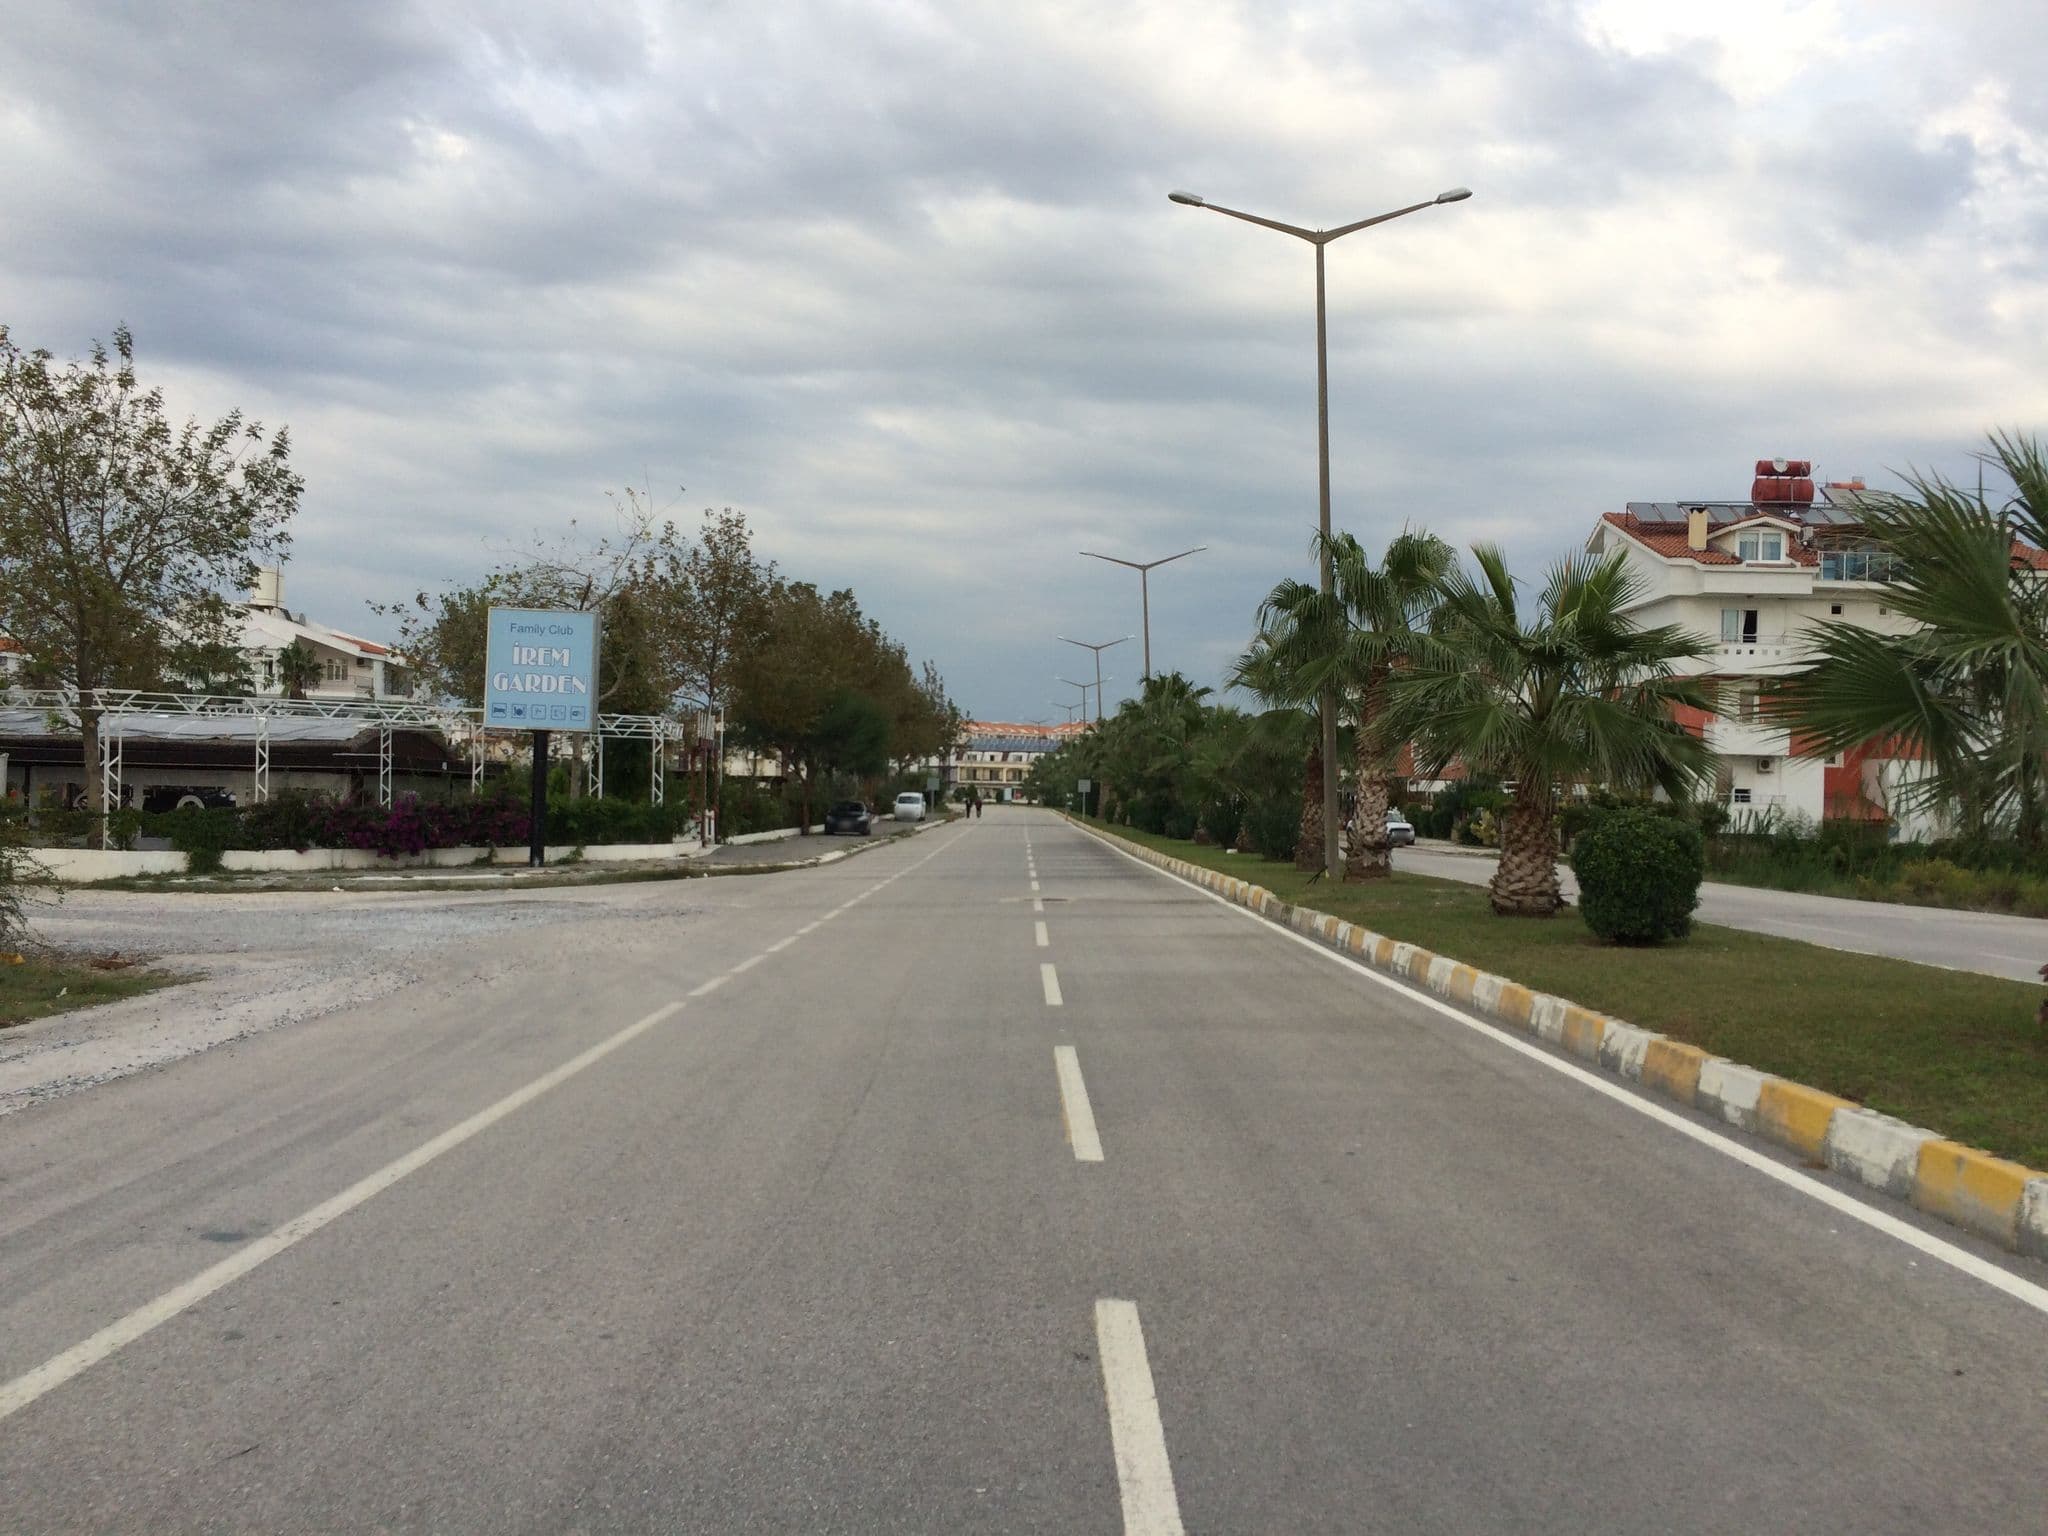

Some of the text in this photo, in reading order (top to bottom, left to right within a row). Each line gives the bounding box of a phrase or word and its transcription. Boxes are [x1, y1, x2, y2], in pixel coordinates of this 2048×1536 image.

[510, 622, 574, 636] Family Club
[512, 641, 571, 667] İREM
[493, 672, 587, 694] GARDEN
